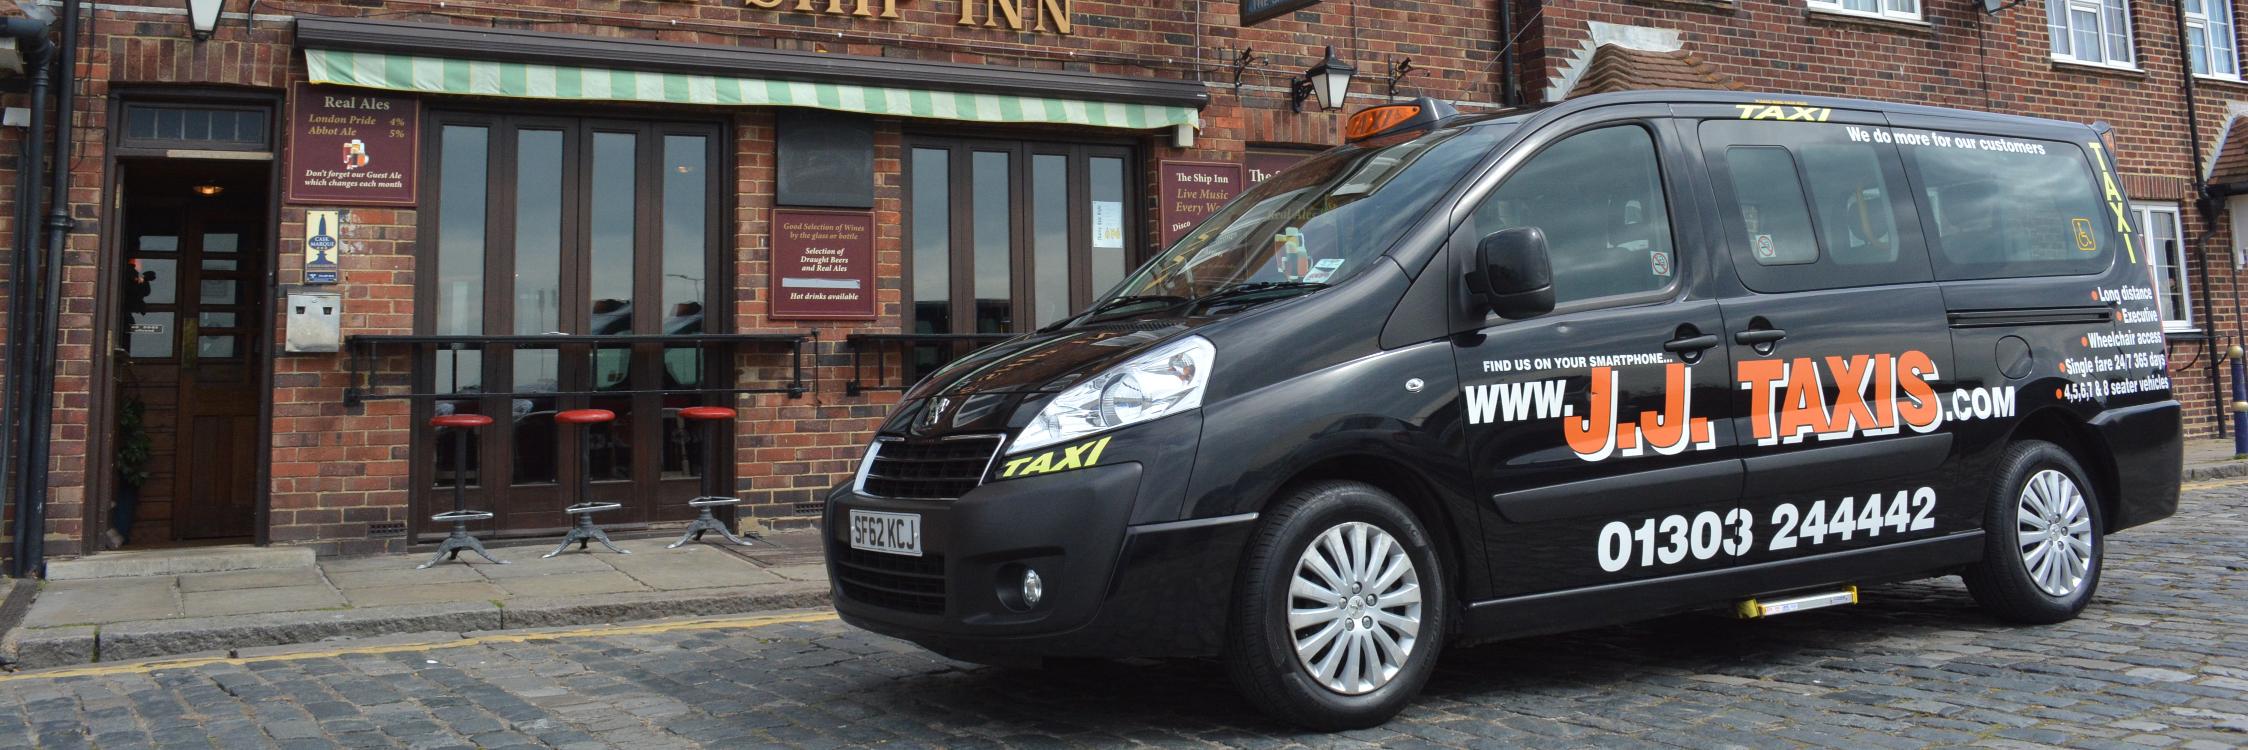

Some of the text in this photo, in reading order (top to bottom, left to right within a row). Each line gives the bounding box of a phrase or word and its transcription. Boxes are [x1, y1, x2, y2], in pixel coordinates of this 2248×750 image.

[324, 96, 390, 110] Real Ales
[308, 114, 347, 124] London
[349, 115, 376, 125] Pride
[1735, 104, 1831, 121] TAXI
[308, 126, 404, 138] Abbot Ale 5%
[1846, 126, 2046, 155] We do more for our customers
[305, 169, 327, 177] Don't
[327, 170, 351, 179] forget
[366, 171, 388, 179] Guest
[389, 171, 402, 179] Ale
[1176, 172, 1229, 185] The Ship Inn
[1248, 169, 1272, 182] The
[328, 180, 358, 188] changes
[1177, 188, 1229, 200] Live Music
[1176, 201, 1203, 215] Every
[2088, 142, 2136, 264] TAXI
[783, 222, 865, 232] Good Selection of Wines
[1172, 221, 1191, 232] Disco
[790, 232, 799, 240] by
[811, 232, 828, 240] glass
[838, 232, 858, 240] bottle
[805, 247, 845, 256] Selection of
[800, 256, 829, 264] Draught
[790, 292, 804, 300] Hot
[804, 292, 827, 300] drinks
[2098, 284, 2153, 305] Long distance
[2122, 307, 2158, 323] Executive
[2087, 330, 2162, 348] Wheelchair access
[1483, 352, 1673, 372] FIND US ON YOUR SMARTPHONE...
[2065, 351, 2165, 378] Single fare 24/7 365 days
[2064, 374, 2169, 403] 4,5,6,7 & 8 seater vehicles
[1003, 436, 1112, 477] TAXI
[854, 515, 915, 550] SF62 KCJ
[1597, 486, 1937, 573] 01303 244442
